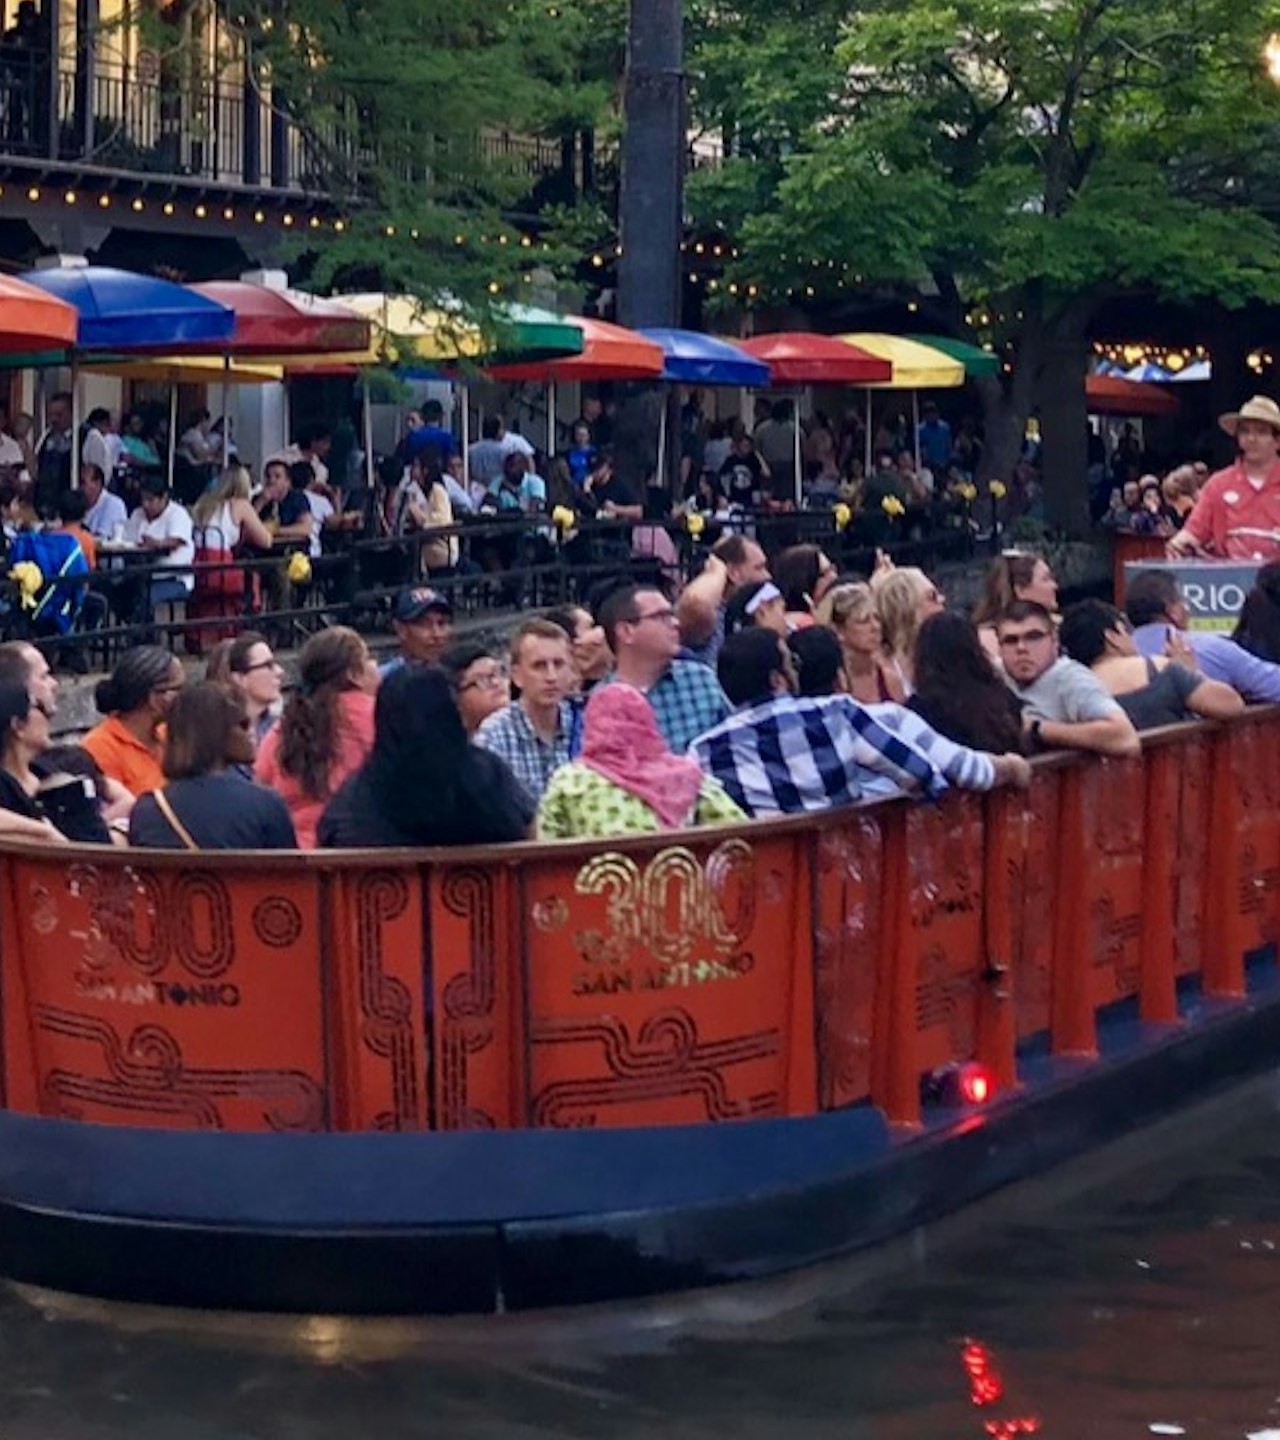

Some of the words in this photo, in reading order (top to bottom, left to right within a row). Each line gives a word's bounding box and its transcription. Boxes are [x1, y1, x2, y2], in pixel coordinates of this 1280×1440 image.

[1182, 583, 1246, 611] RIO
[575, 839, 756, 964] 300
[573, 969, 632, 996] SAN
